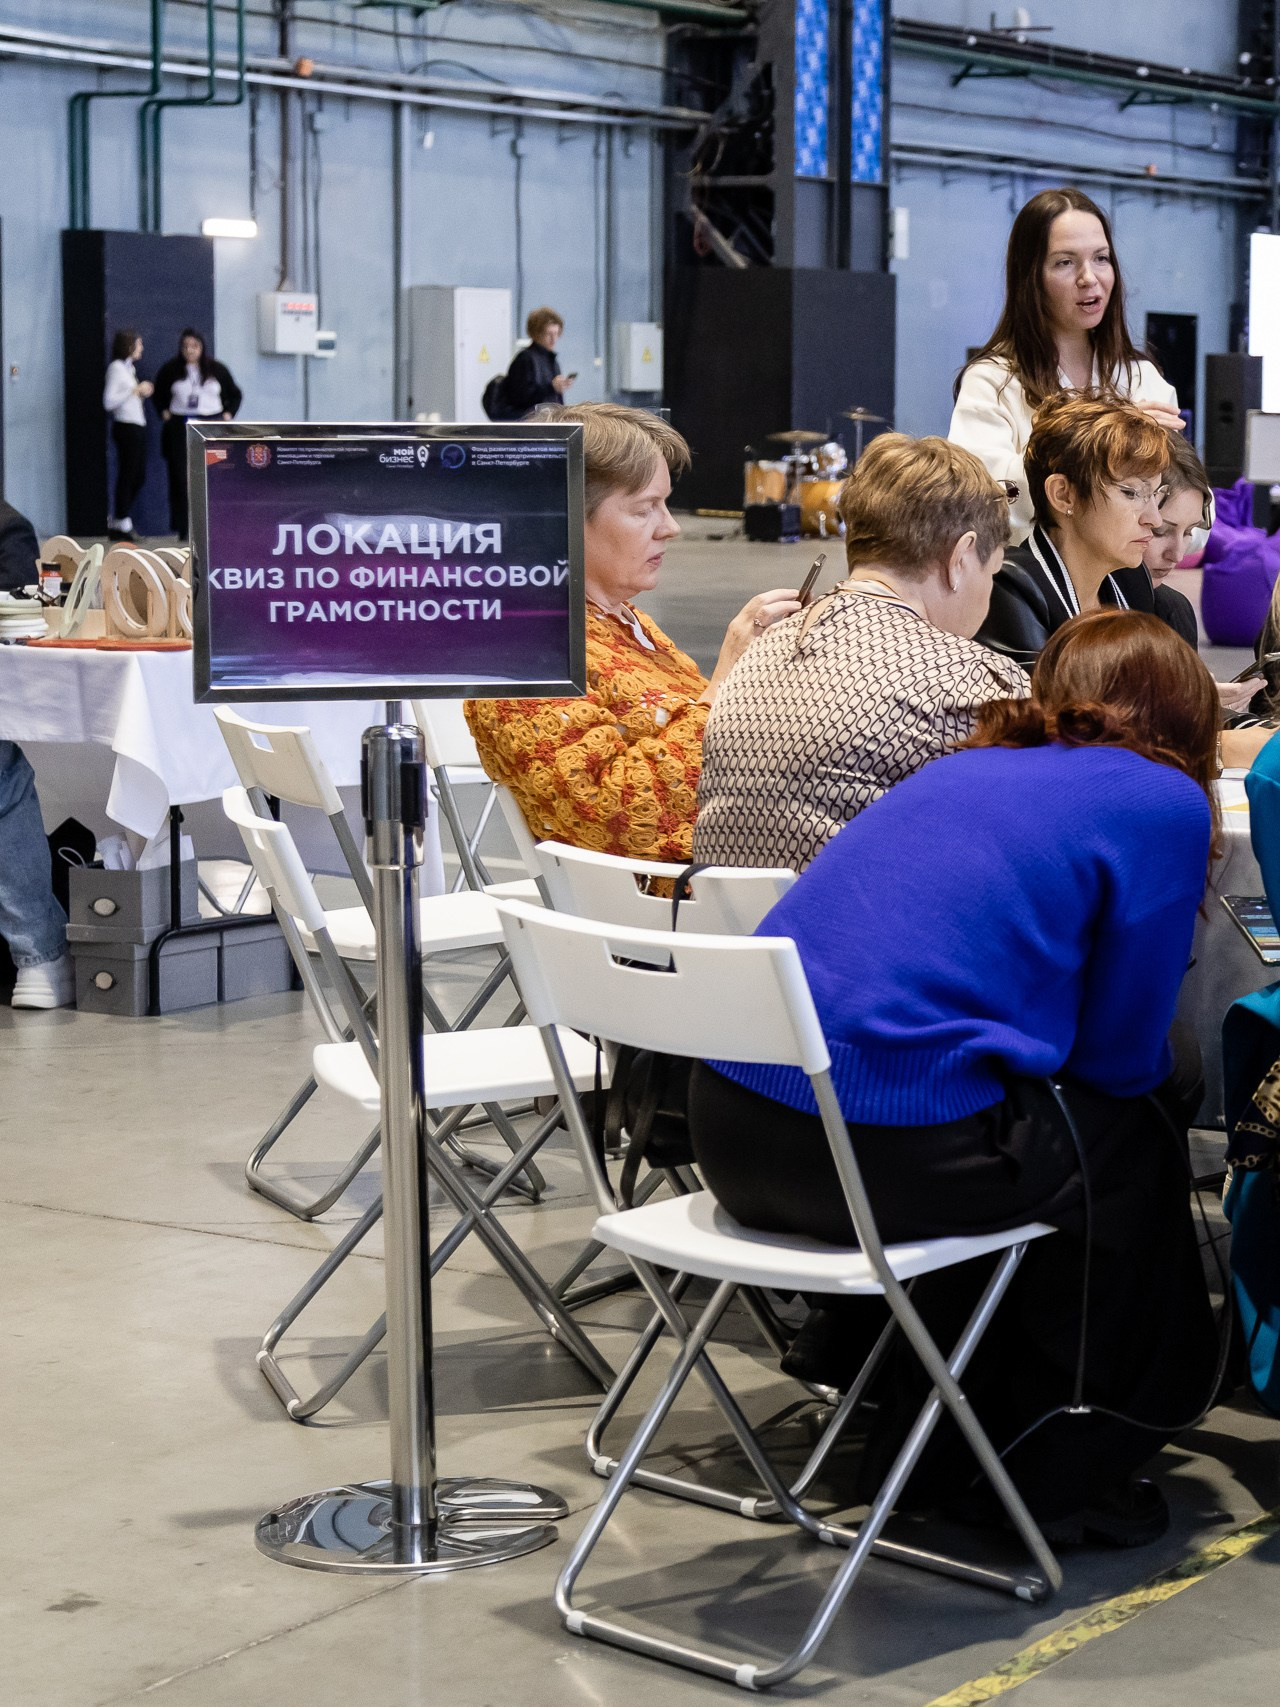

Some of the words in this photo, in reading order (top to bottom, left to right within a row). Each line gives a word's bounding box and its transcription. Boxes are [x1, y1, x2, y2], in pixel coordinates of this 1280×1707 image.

[379, 453, 415, 464] бизнес
[393, 446, 414, 456] мой
[272, 522, 502, 560] ЛОКАЦИЯ
[208, 566, 285, 590] КВИЗ
[295, 566, 339, 589] ПО
[349, 560, 570, 589] ФИНАНСОВОЙ
[269, 599, 502, 623] ГРАМОТНОСТИ
